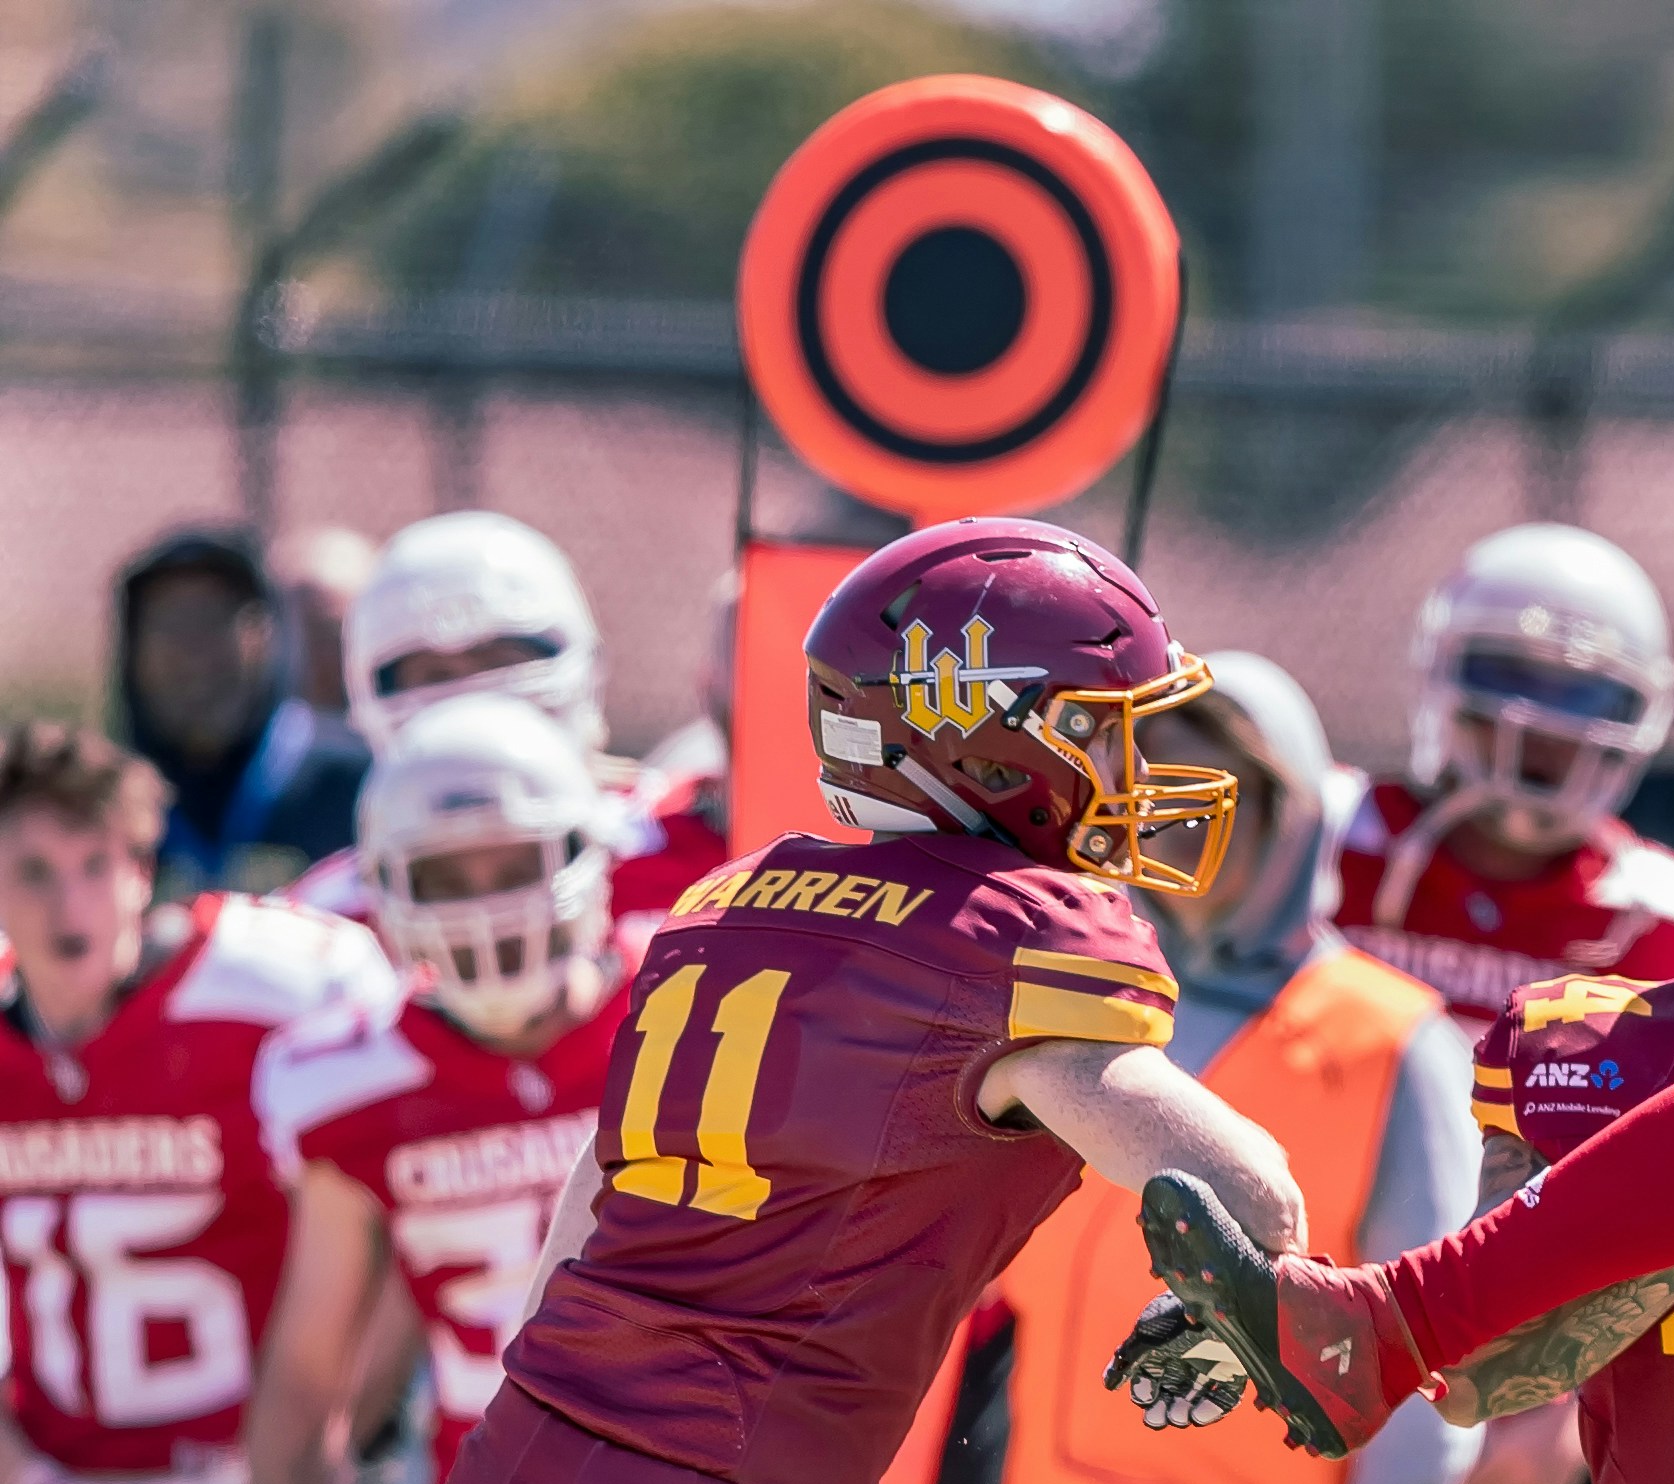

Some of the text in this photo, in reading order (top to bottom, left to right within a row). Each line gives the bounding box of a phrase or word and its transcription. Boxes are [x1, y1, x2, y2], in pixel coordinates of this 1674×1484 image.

[901, 614, 995, 740] W
[670, 869, 935, 927] WARREN
[611, 964, 791, 1221] 11
[1525, 1062, 1591, 1088] ANZ
[5, 1192, 253, 1428] 16
